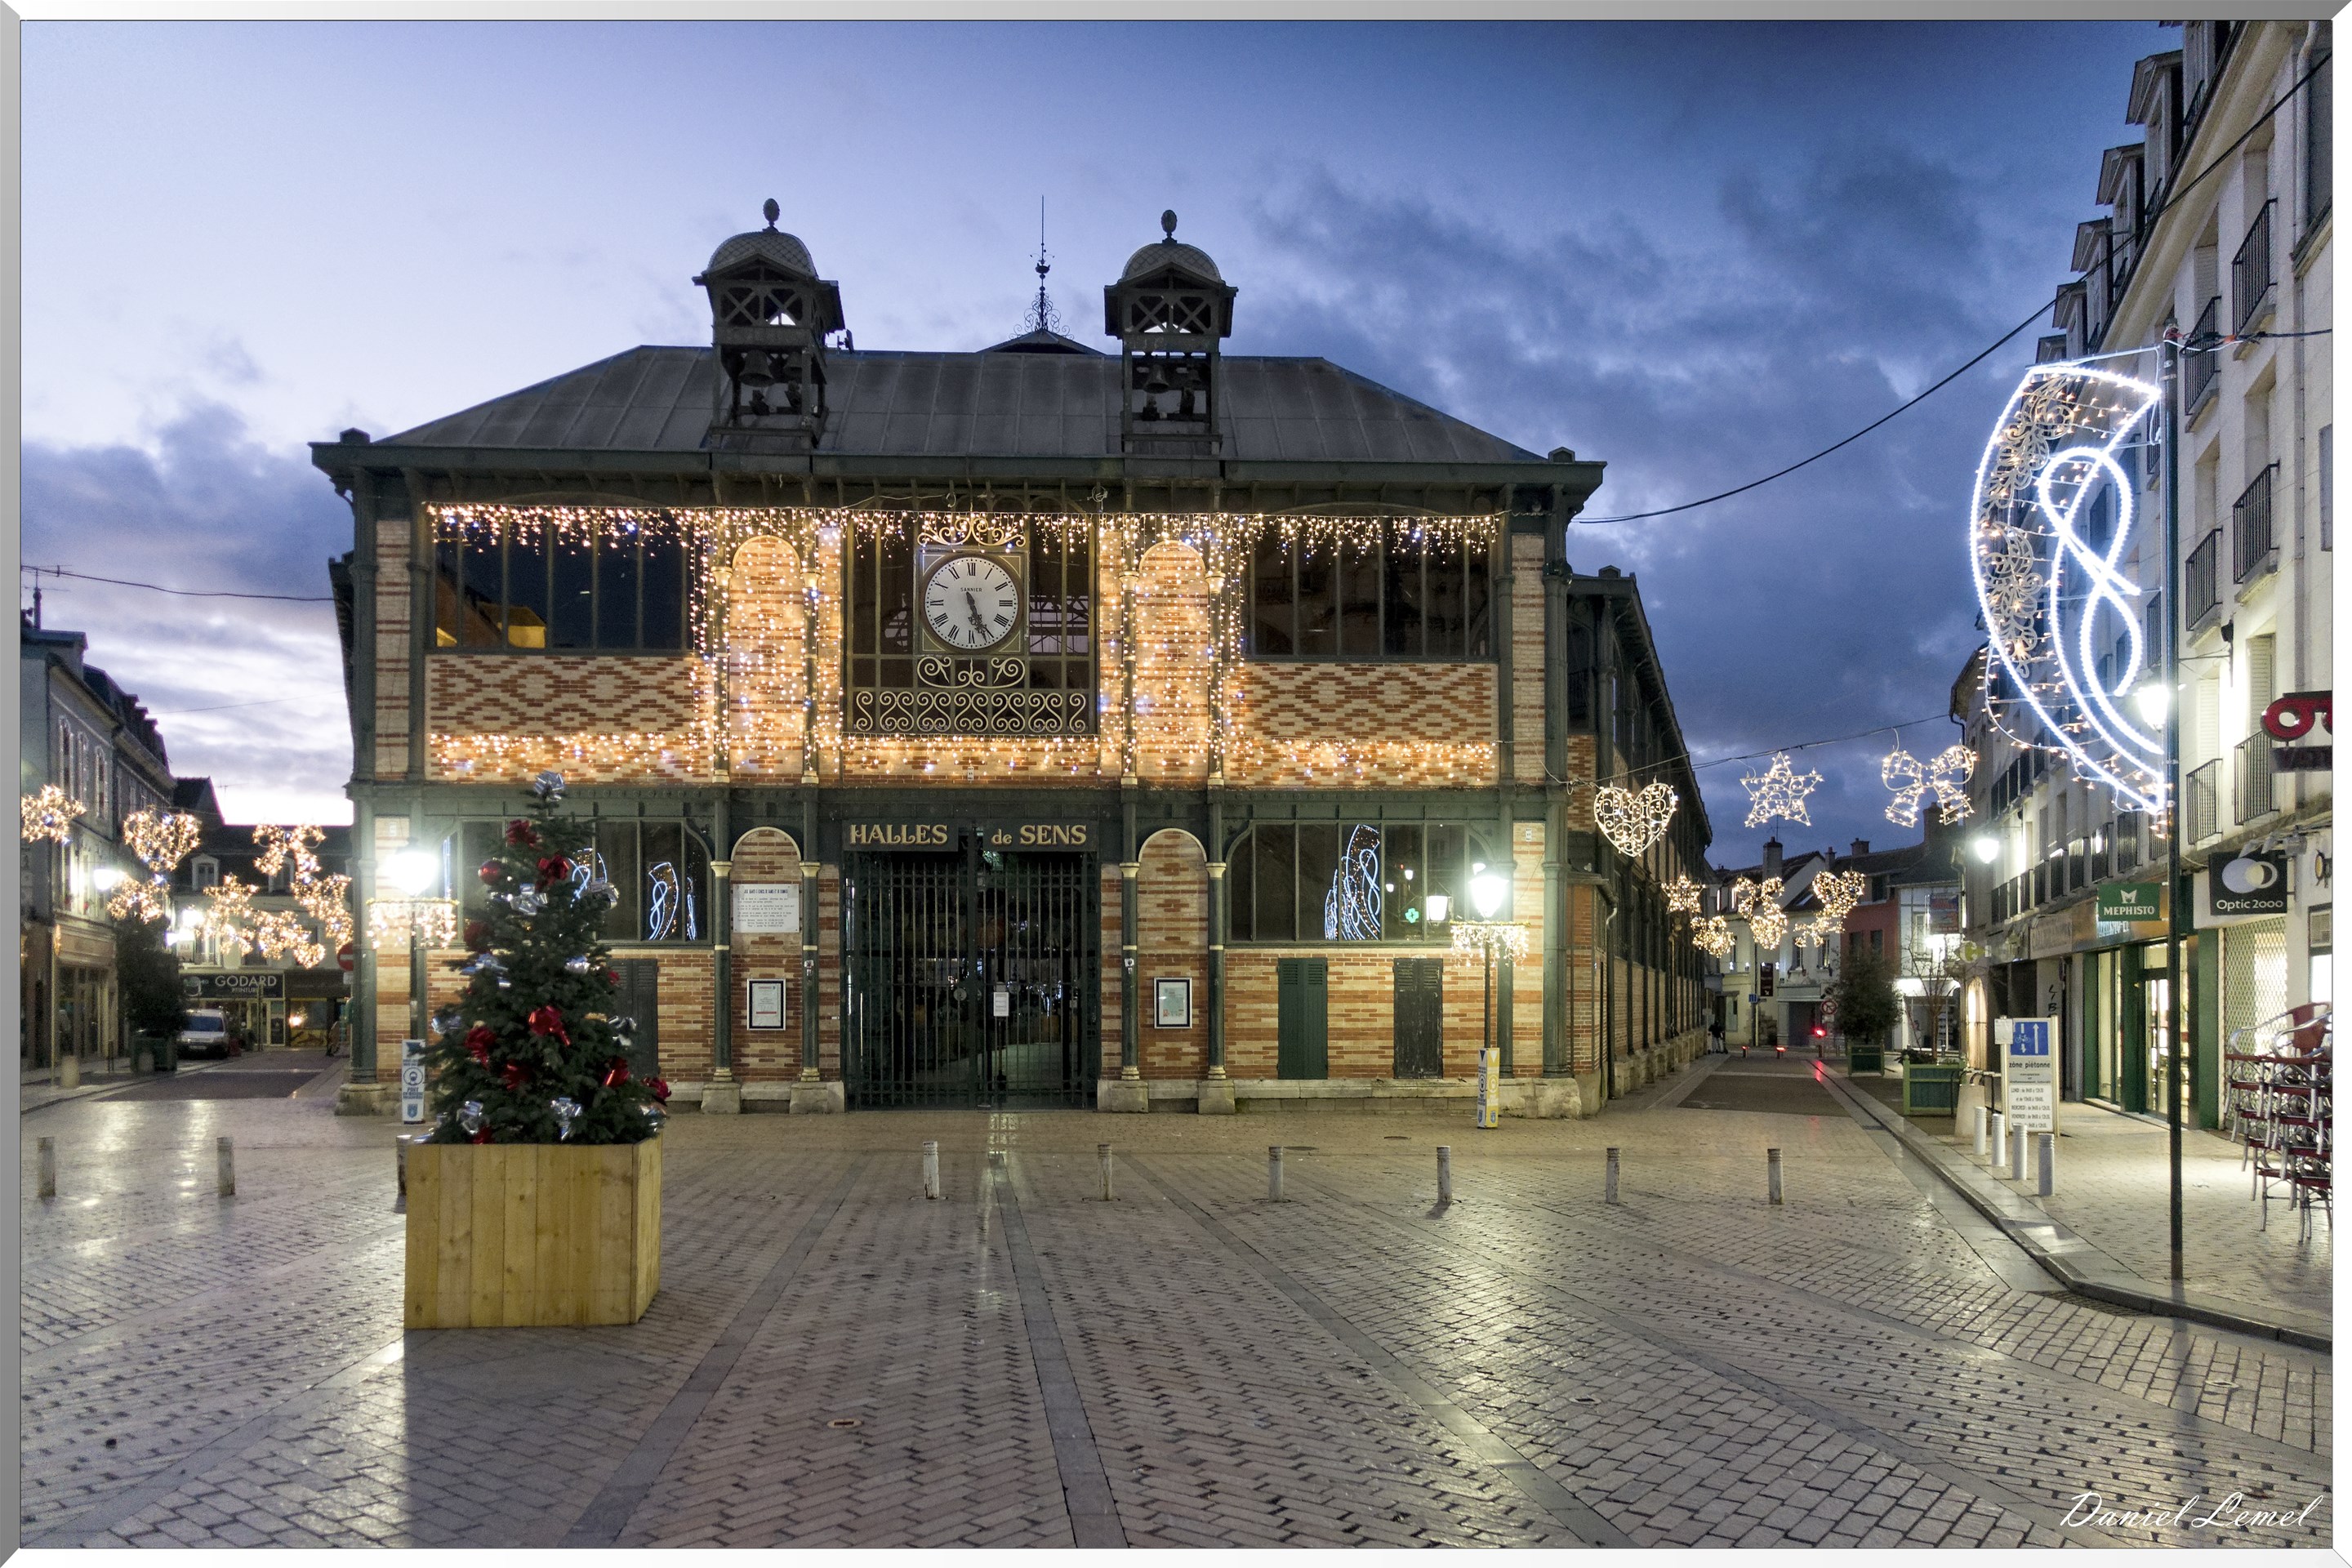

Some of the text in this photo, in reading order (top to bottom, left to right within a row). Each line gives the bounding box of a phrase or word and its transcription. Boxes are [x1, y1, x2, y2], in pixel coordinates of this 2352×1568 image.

[849, 824, 1087, 845] HALLES de SENS
[2104, 905, 2155, 915] MEPHISTO
[2216, 899, 2283, 911] Optic 2000
[215, 975, 277, 987] GODARD
